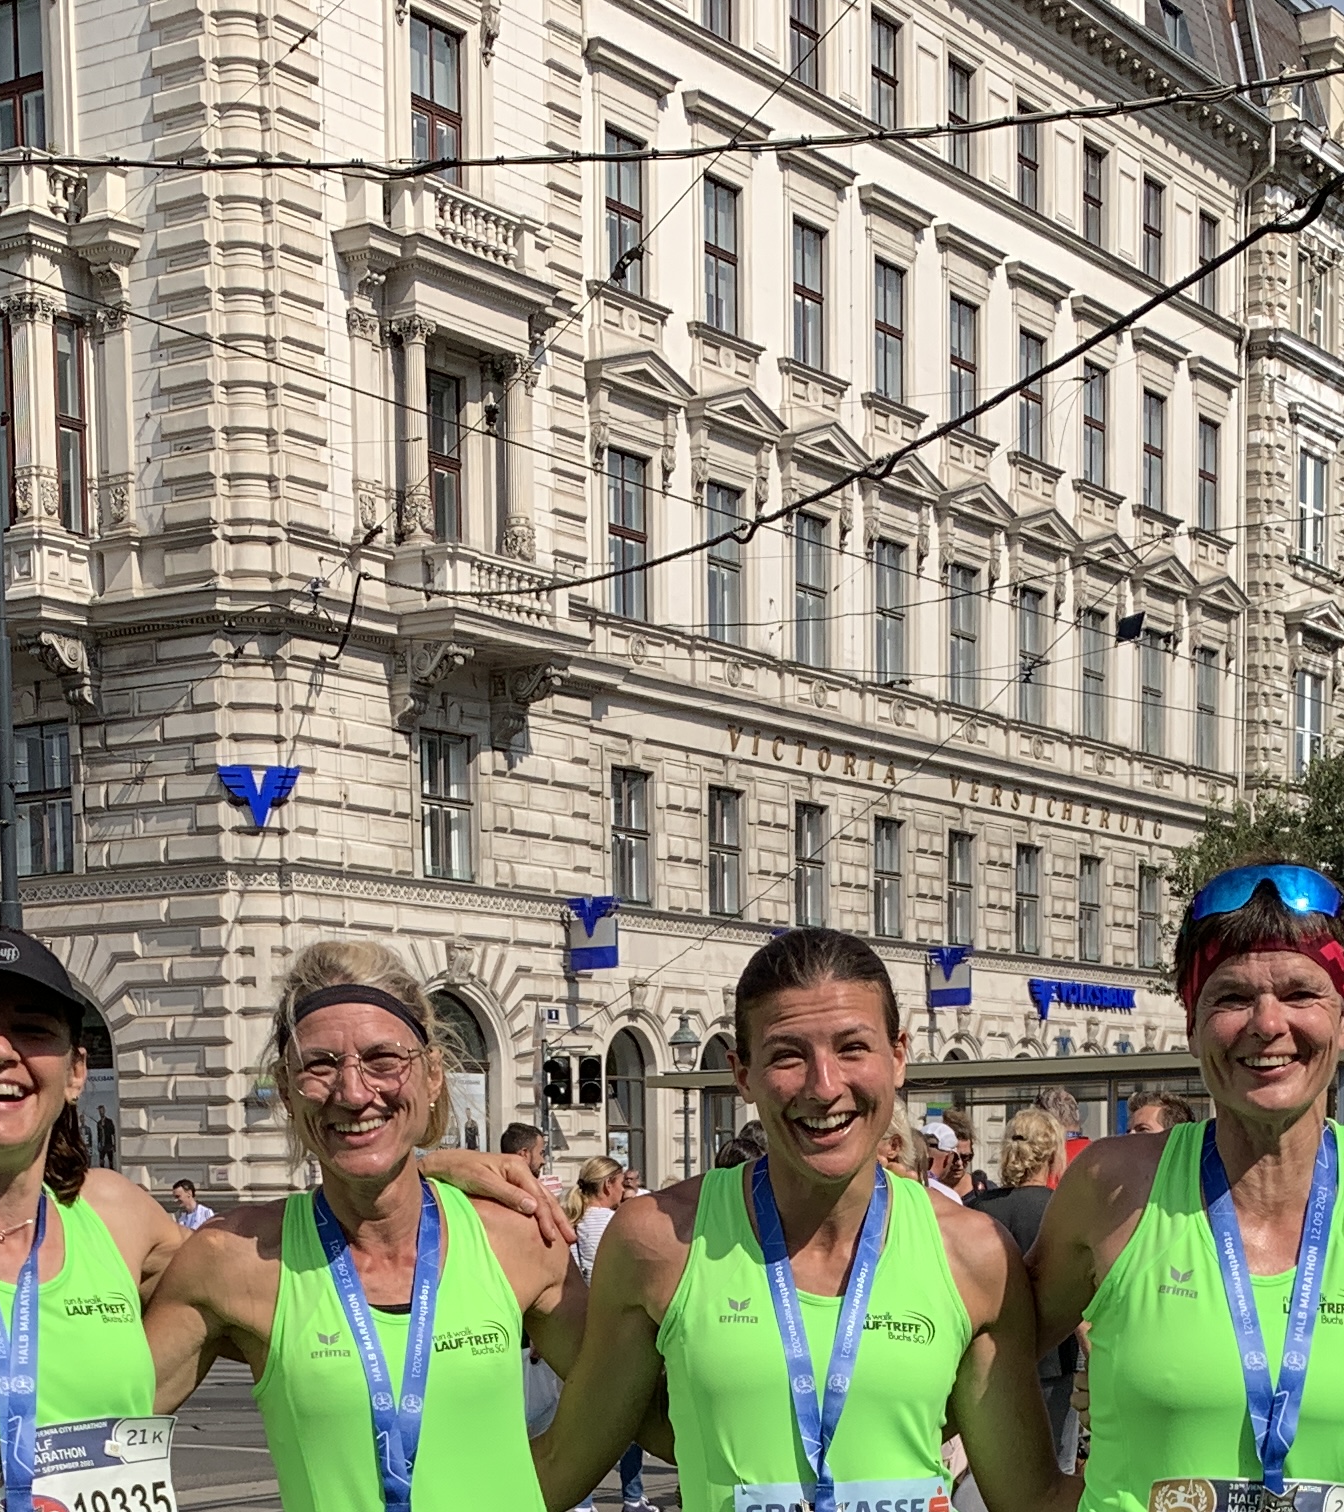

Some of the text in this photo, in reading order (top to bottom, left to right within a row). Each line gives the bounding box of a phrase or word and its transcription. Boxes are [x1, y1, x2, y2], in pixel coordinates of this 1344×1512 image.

[727, 725, 1164, 840] VICTORIA VERSICHERUNG
[1293, 1187, 1328, 1342] HALB MARATHON 12.09.2021
[1159, 1284, 1198, 1299] erima
[66, 1303, 126, 1316] LAUF-TREFF
[871, 1312, 893, 1320] walk
[18, 1271, 33, 1365] HALB MARATHON
[347, 1293, 374, 1351] MARATHON
[719, 1313, 758, 1324] erima
[1321, 1316, 1343, 1325] Buchs
[452, 1327, 473, 1337] walk
[888, 1332, 925, 1344] Buchs SG
[435, 1332, 499, 1353] LAUF-TREFF
[311, 1349, 351, 1359] erima
[471, 1344, 505, 1356] Buchs SG
[368, 1353, 383, 1382] HALB
[34, 1446, 87, 1465] ARATHON
